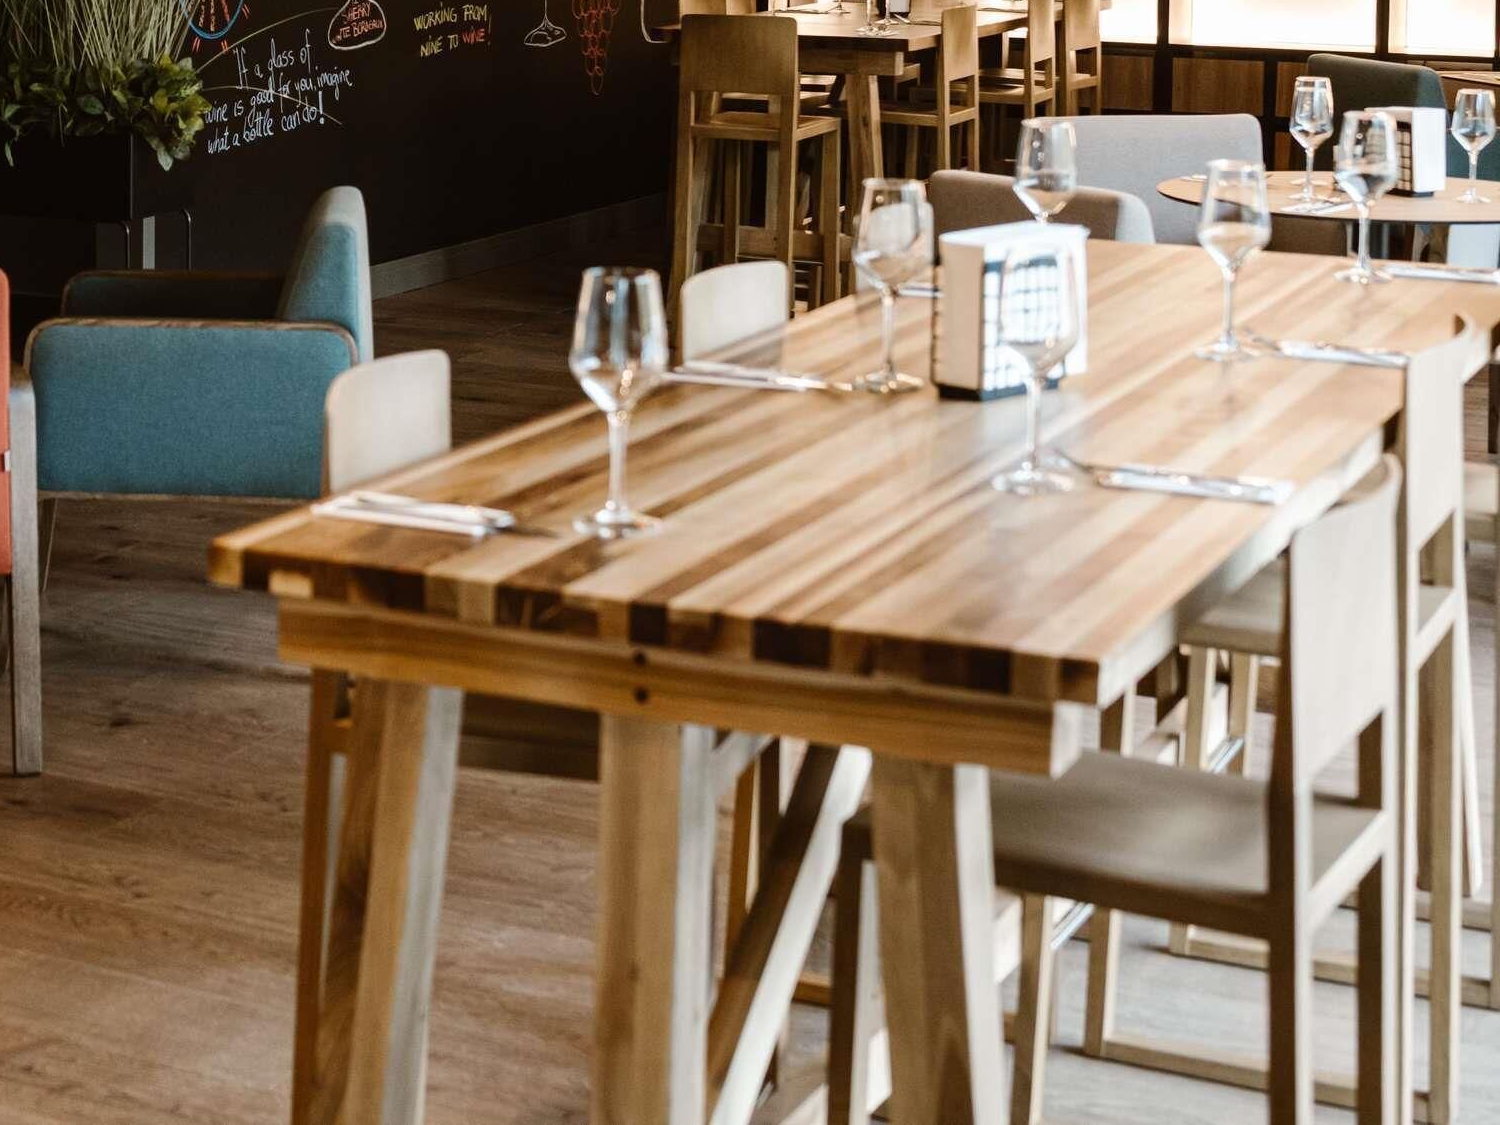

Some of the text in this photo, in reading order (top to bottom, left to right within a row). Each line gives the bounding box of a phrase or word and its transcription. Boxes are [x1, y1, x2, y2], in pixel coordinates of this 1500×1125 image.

[413, 1, 489, 32] WORKING FROM
[234, 28, 311, 91] If a glass of
[419, 34, 443, 57] NINE
[447, 33, 459, 51] TO
[204, 102, 228, 124] wine
[233, 99, 245, 117] is
[244, 75, 276, 126] good
[315, 65, 354, 101] imagine
[207, 125, 231, 155] what
[232, 133, 241, 146] a
[242, 108, 275, 143] bottle
[281, 110, 301, 132] can
